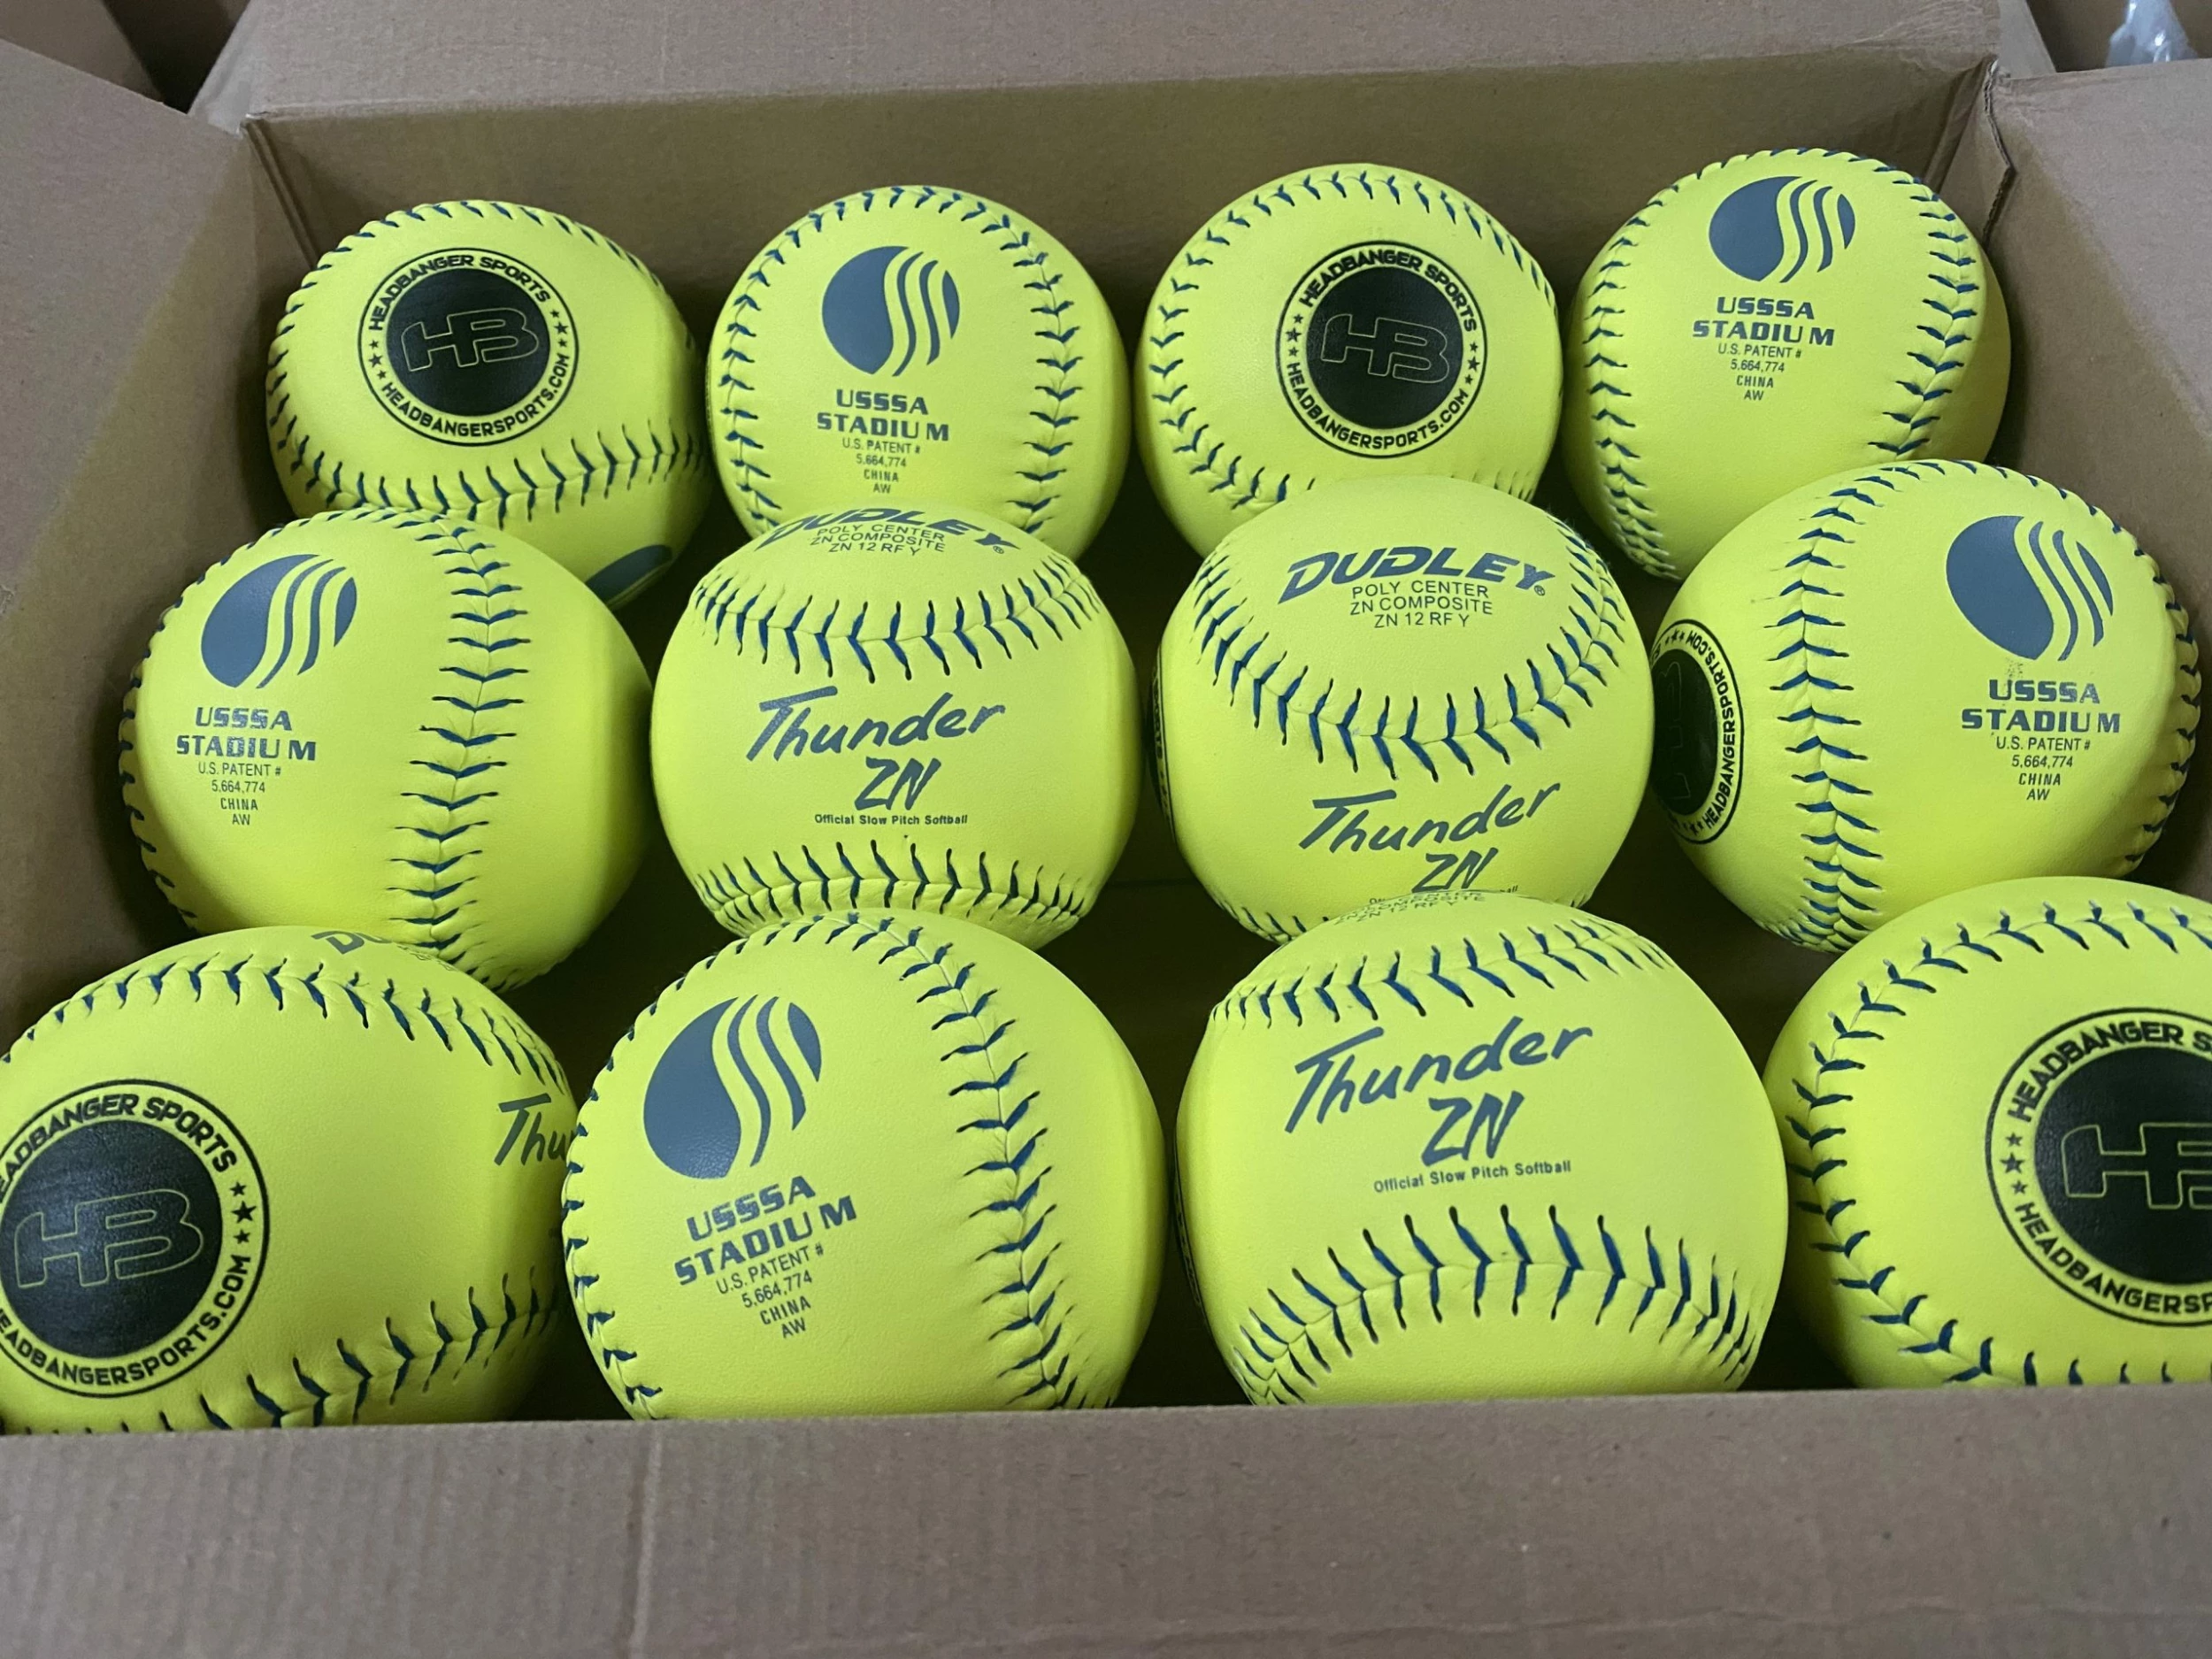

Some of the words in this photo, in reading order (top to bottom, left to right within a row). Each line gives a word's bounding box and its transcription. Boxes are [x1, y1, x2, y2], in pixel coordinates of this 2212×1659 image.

[369, 255, 474, 331] HEADBANGER
[480, 257, 551, 303] SPORTS
[1299, 249, 1423, 308] HEADBANGER
[1425, 264, 1477, 332] SPORTS
[1717, 296, 1815, 319] USSSA
[401, 307, 539, 372] HB
[1693, 320, 1834, 346] STADIUM
[1321, 314, 1449, 384] HB
[1718, 343, 1740, 355] U.S.
[1745, 344, 1793, 358] PATENT
[1737, 375, 1773, 388] CHINA
[382, 353, 570, 437] HEADBANGERSPORTS.COM
[836, 389, 928, 415] USSSA
[1287, 362, 1469, 449] HEADBANGERSPORTS.COM
[1744, 390, 1763, 401] AW
[817, 412, 949, 442] STADIUM
[842, 438, 864, 449] U.S.
[867, 440, 911, 453] PATENT
[864, 469, 899, 482] CHINA
[873, 483, 891, 494] AW
[754, 508, 1020, 551] DUDLEY
[810, 535, 833, 545] ZN
[838, 533, 946, 552] COMPOSITE
[817, 524, 864, 536] POLY
[871, 524, 945, 541] CENTER
[828, 542, 851, 552] ZN
[859, 541, 875, 551] 12
[1278, 546, 1555, 604] DUDLEY
[1352, 581, 1401, 598] POLY
[1411, 580, 1488, 598] CENTER
[1350, 599, 1373, 615] ZN
[1379, 595, 1493, 615] COMPOSITE
[1375, 614, 1398, 628] ZN
[1405, 612, 1424, 626] 12
[1989, 680, 2100, 703] USSSA
[196, 707, 292, 731] USSSA
[746, 686, 1006, 761] Thunder
[1685, 630, 1736, 829] HEADBANGERSPORTS.COM
[1962, 709, 2120, 733] STADIUM
[177, 735, 316, 761] STADIUM
[1997, 735, 2024, 749] U.S.
[2028, 737, 2081, 750] PATENT
[199, 762, 219, 775] U.S.
[223, 763, 271, 776] PATENT
[2011, 755, 2073, 769] 5,664,774
[854, 756, 941, 810] ZN
[2018, 773, 2061, 785] CHINA
[221, 797, 257, 810] CHINA
[2026, 788, 2050, 801] AW
[232, 814, 250, 825] AW
[814, 814, 854, 825] Official
[859, 815, 887, 825] Slow
[892, 815, 919, 825] Pitch
[925, 814, 968, 825] Softball
[1299, 782, 1560, 853] Thunder
[1411, 848, 1498, 893] ZN
[1285, 1016, 1593, 1133] Thunder
[2007, 1021, 2185, 1122] HEADBANGER
[143, 1097, 237, 1173] SPORTS
[1422, 1090, 1525, 1166] ZN
[1373, 1174, 1424, 1193] Official
[1431, 1171, 1465, 1185] Slow
[1471, 1166, 1509, 1179] Pitch
[1515, 1160, 1571, 1176] Softball
[687, 1176, 816, 1241] USSSA
[14, 1189, 204, 1288] HB
[674, 1195, 856, 1286] STADIUM
[716, 1272, 747, 1294] U.S.
[749, 1246, 810, 1283] PATENT
[2015, 1202, 2212, 1314] HEADBANGERSP
[0, 1255, 250, 1386] EADBANGERSPORTS.COM
[760, 1295, 810, 1325] CHINA
[781, 1317, 806, 1339] AW
